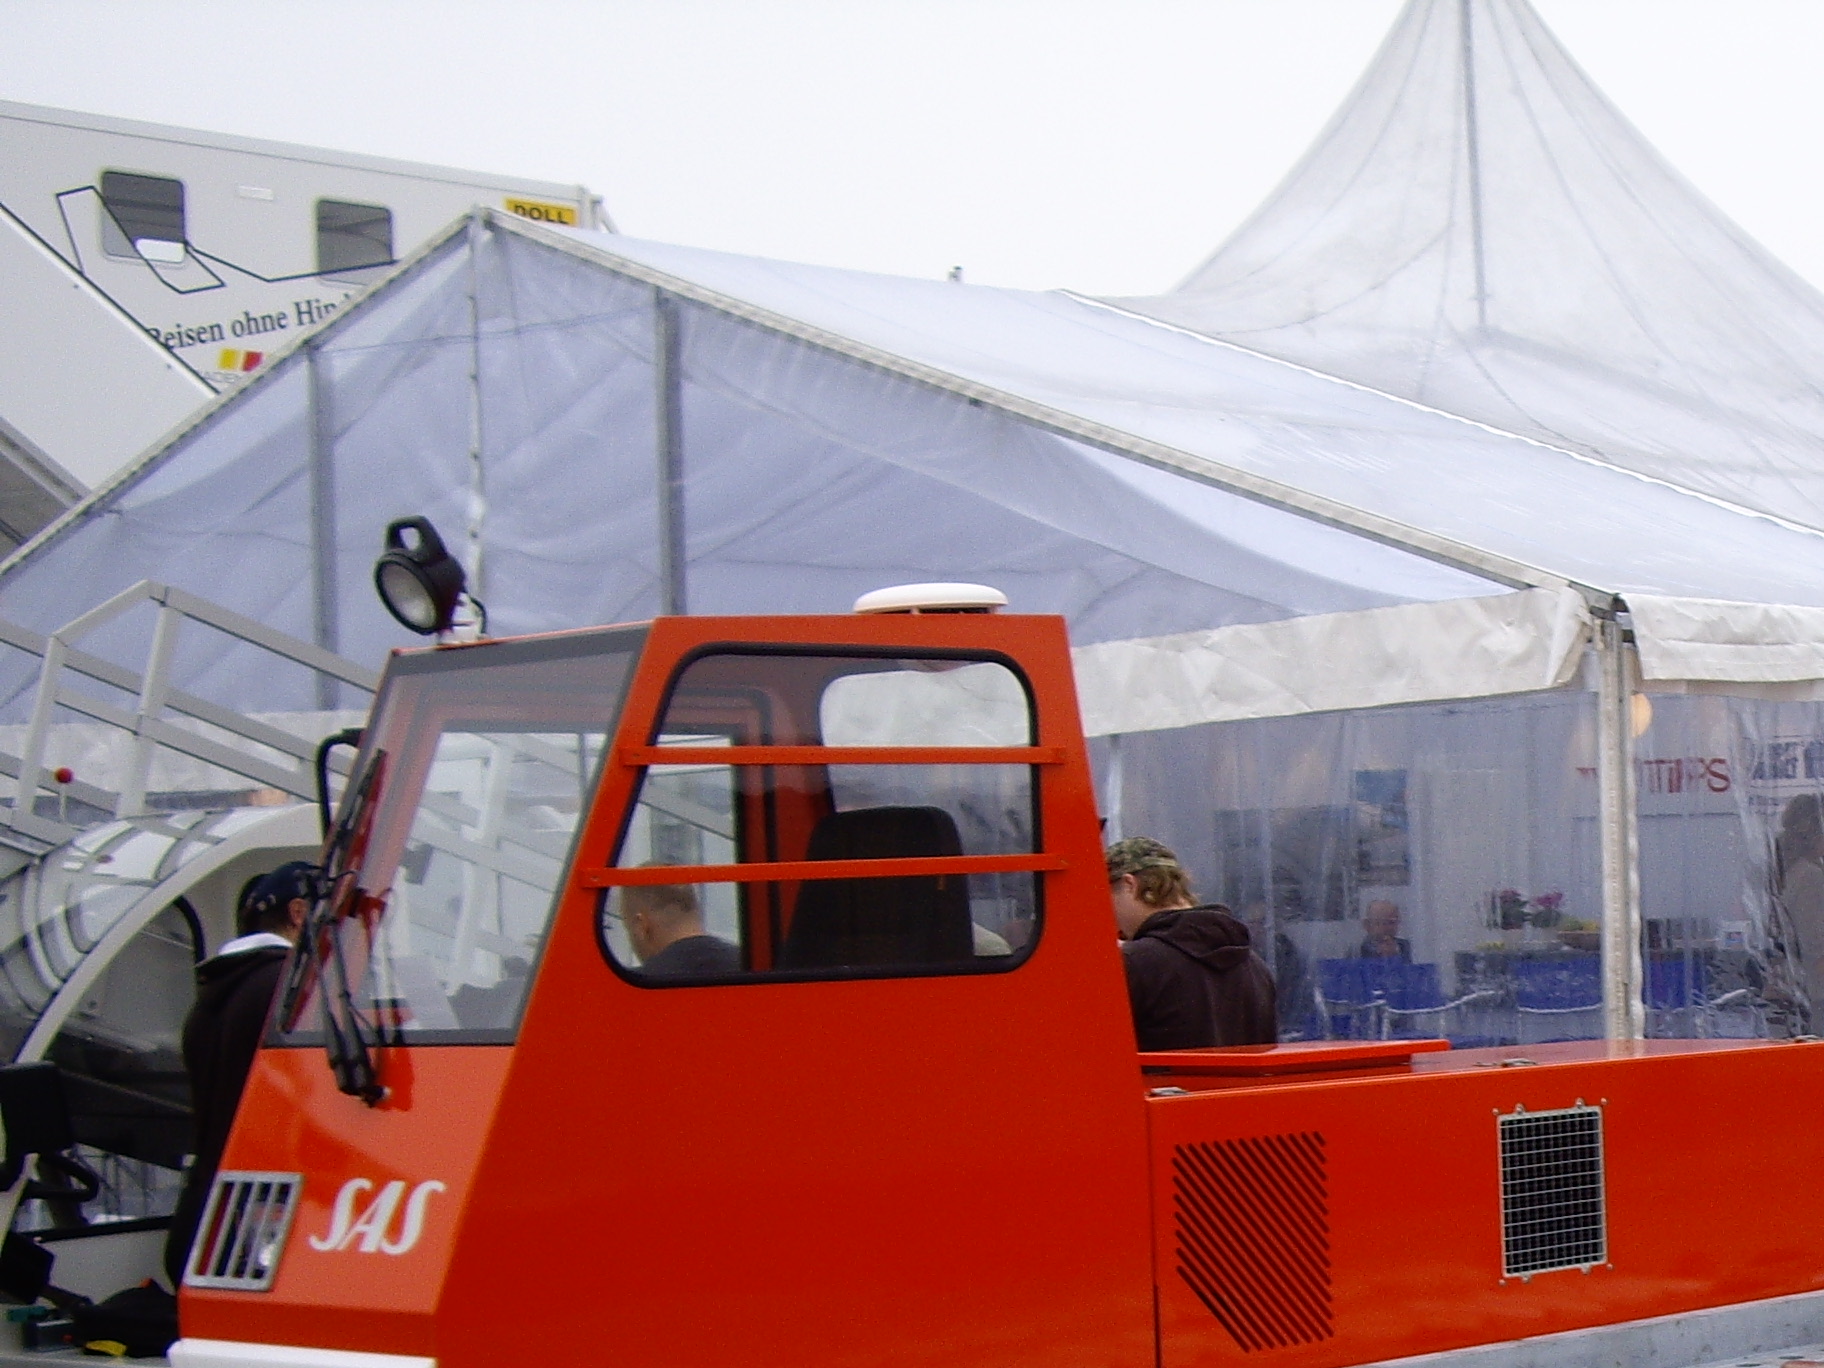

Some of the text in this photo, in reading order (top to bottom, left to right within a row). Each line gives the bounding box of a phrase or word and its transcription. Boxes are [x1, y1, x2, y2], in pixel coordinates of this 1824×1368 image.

[514, 204, 568, 226] DOLL
[230, 310, 288, 339] ohne
[309, 1178, 447, 1256] SAS
